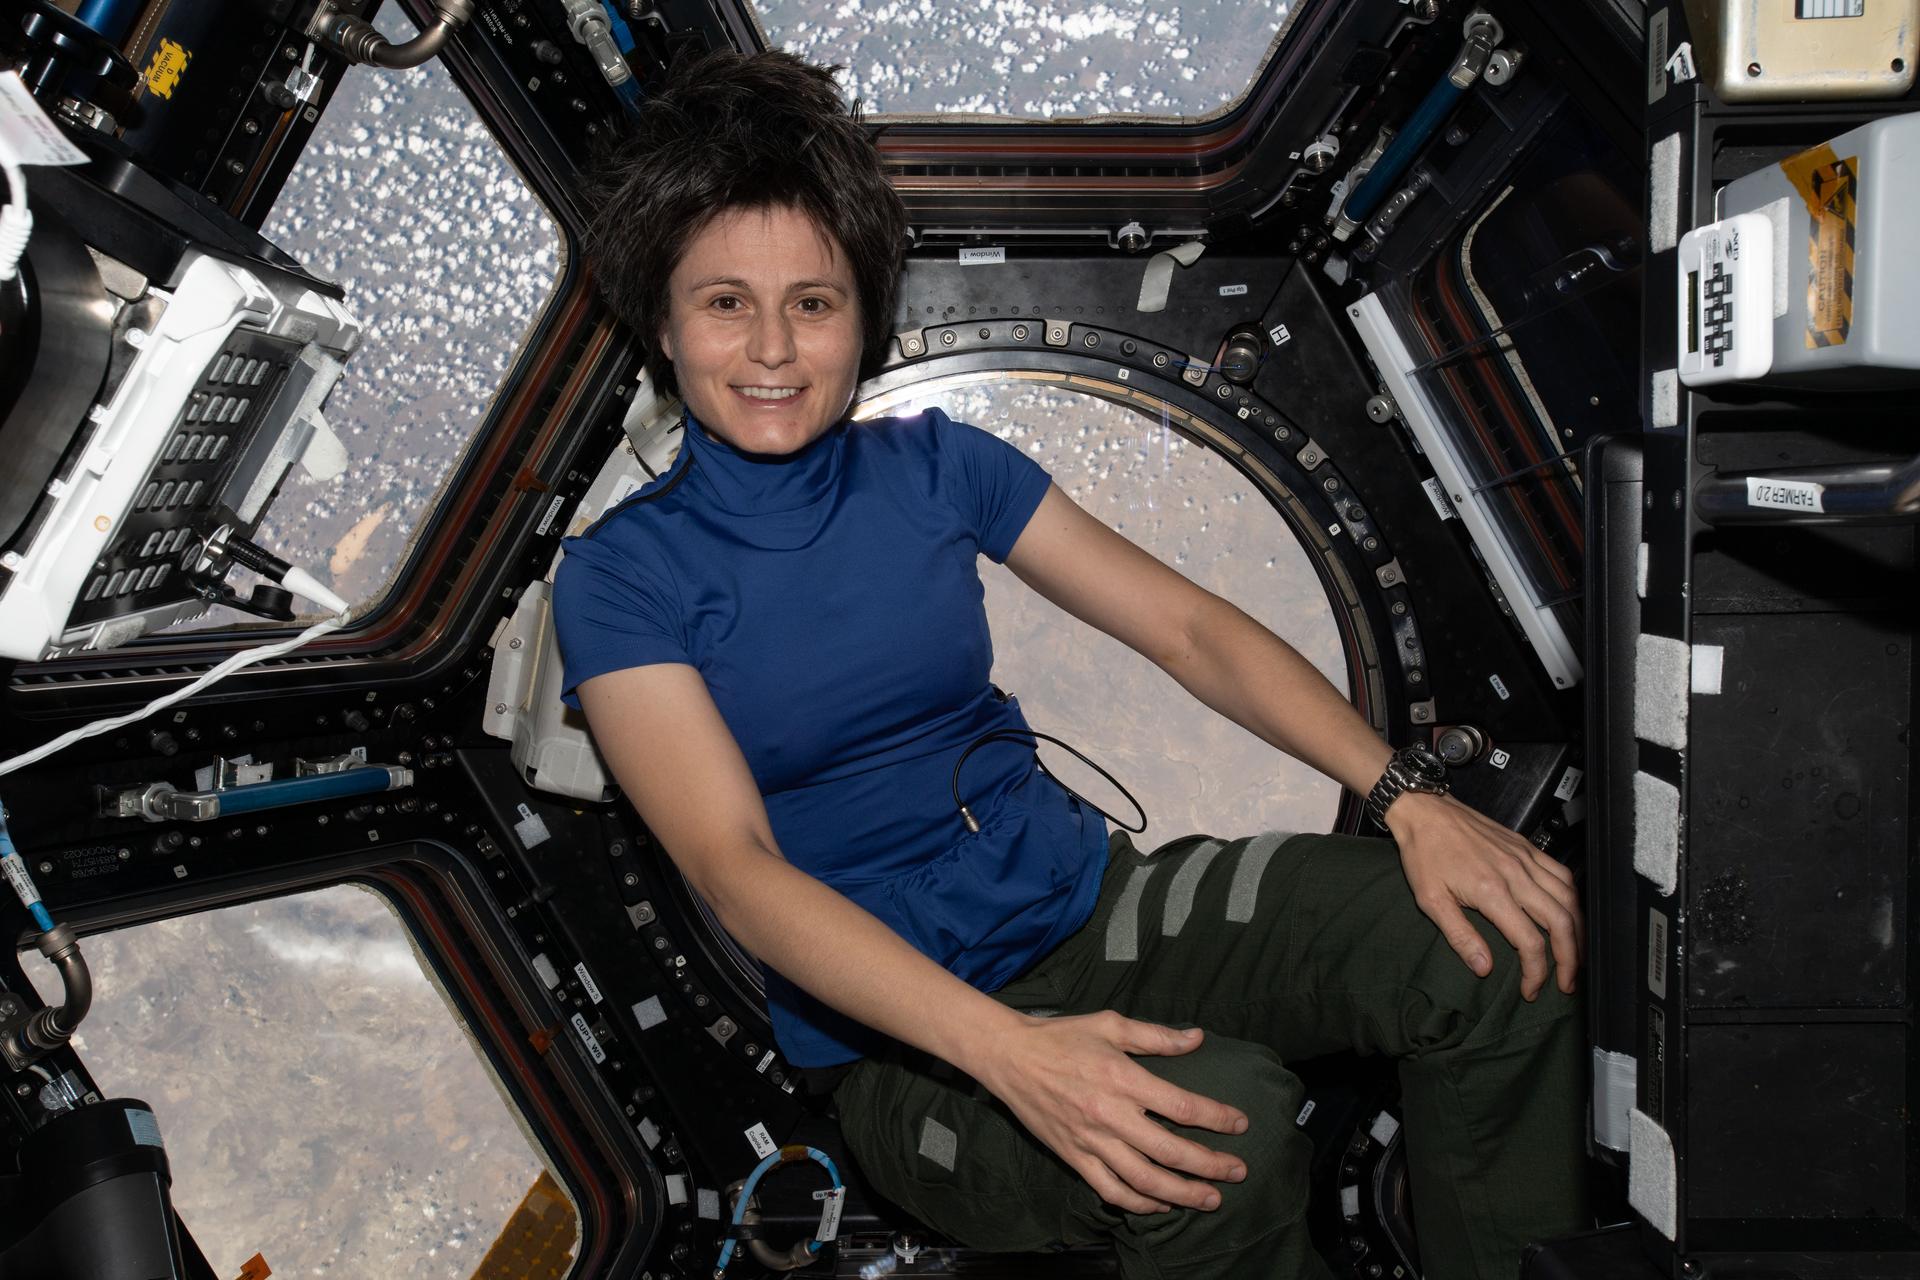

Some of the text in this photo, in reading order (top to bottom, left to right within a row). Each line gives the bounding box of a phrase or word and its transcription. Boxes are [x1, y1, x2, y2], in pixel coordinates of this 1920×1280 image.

[152, 52, 173, 82] VACUUM
[1817, 250, 1826, 311] CAUTION
[1433, 488, 1449, 515] Window
[1756, 485, 1814, 506] FARMER 2.0
[543, 499, 562, 525] Window
[1492, 752, 1507, 765] G
[578, 966, 596, 994] Window
[576, 1018, 601, 1058] CUP1_W5
[760, 1132, 770, 1145] RAM
